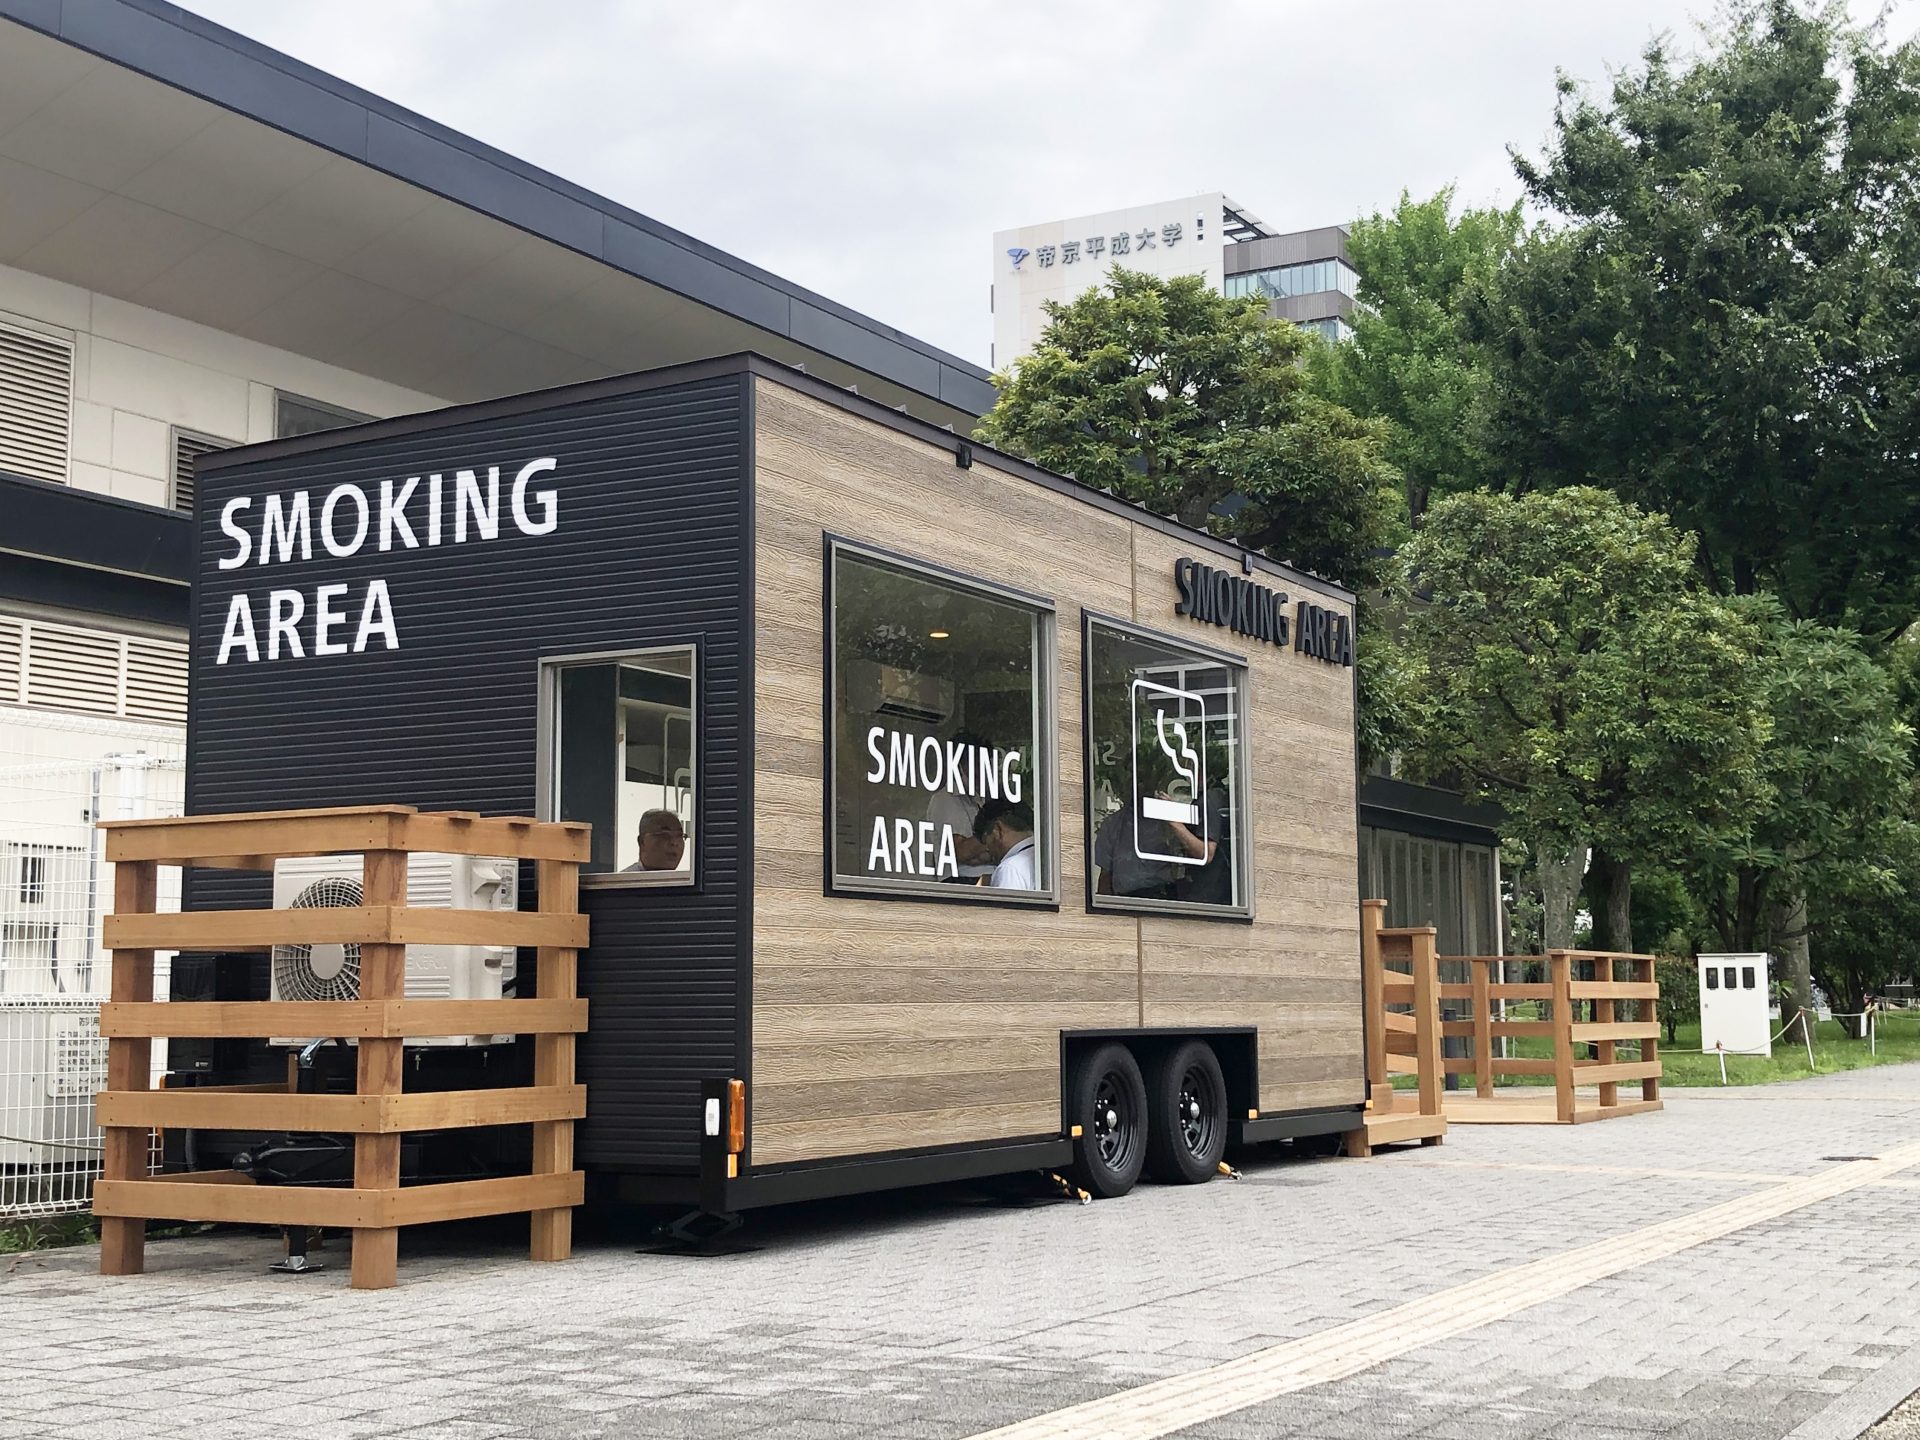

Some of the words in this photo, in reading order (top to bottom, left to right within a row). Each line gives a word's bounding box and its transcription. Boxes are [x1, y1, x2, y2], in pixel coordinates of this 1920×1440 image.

[1036, 223, 1183, 268] 帝京平成大学
[219, 457, 557, 570] SMOKING
[216, 580, 400, 665] AREA
[1175, 557, 1289, 646] SMOKING
[1295, 601, 1352, 667] AREA
[867, 726, 1022, 803] SMOKING
[868, 815, 959, 878] AREA
